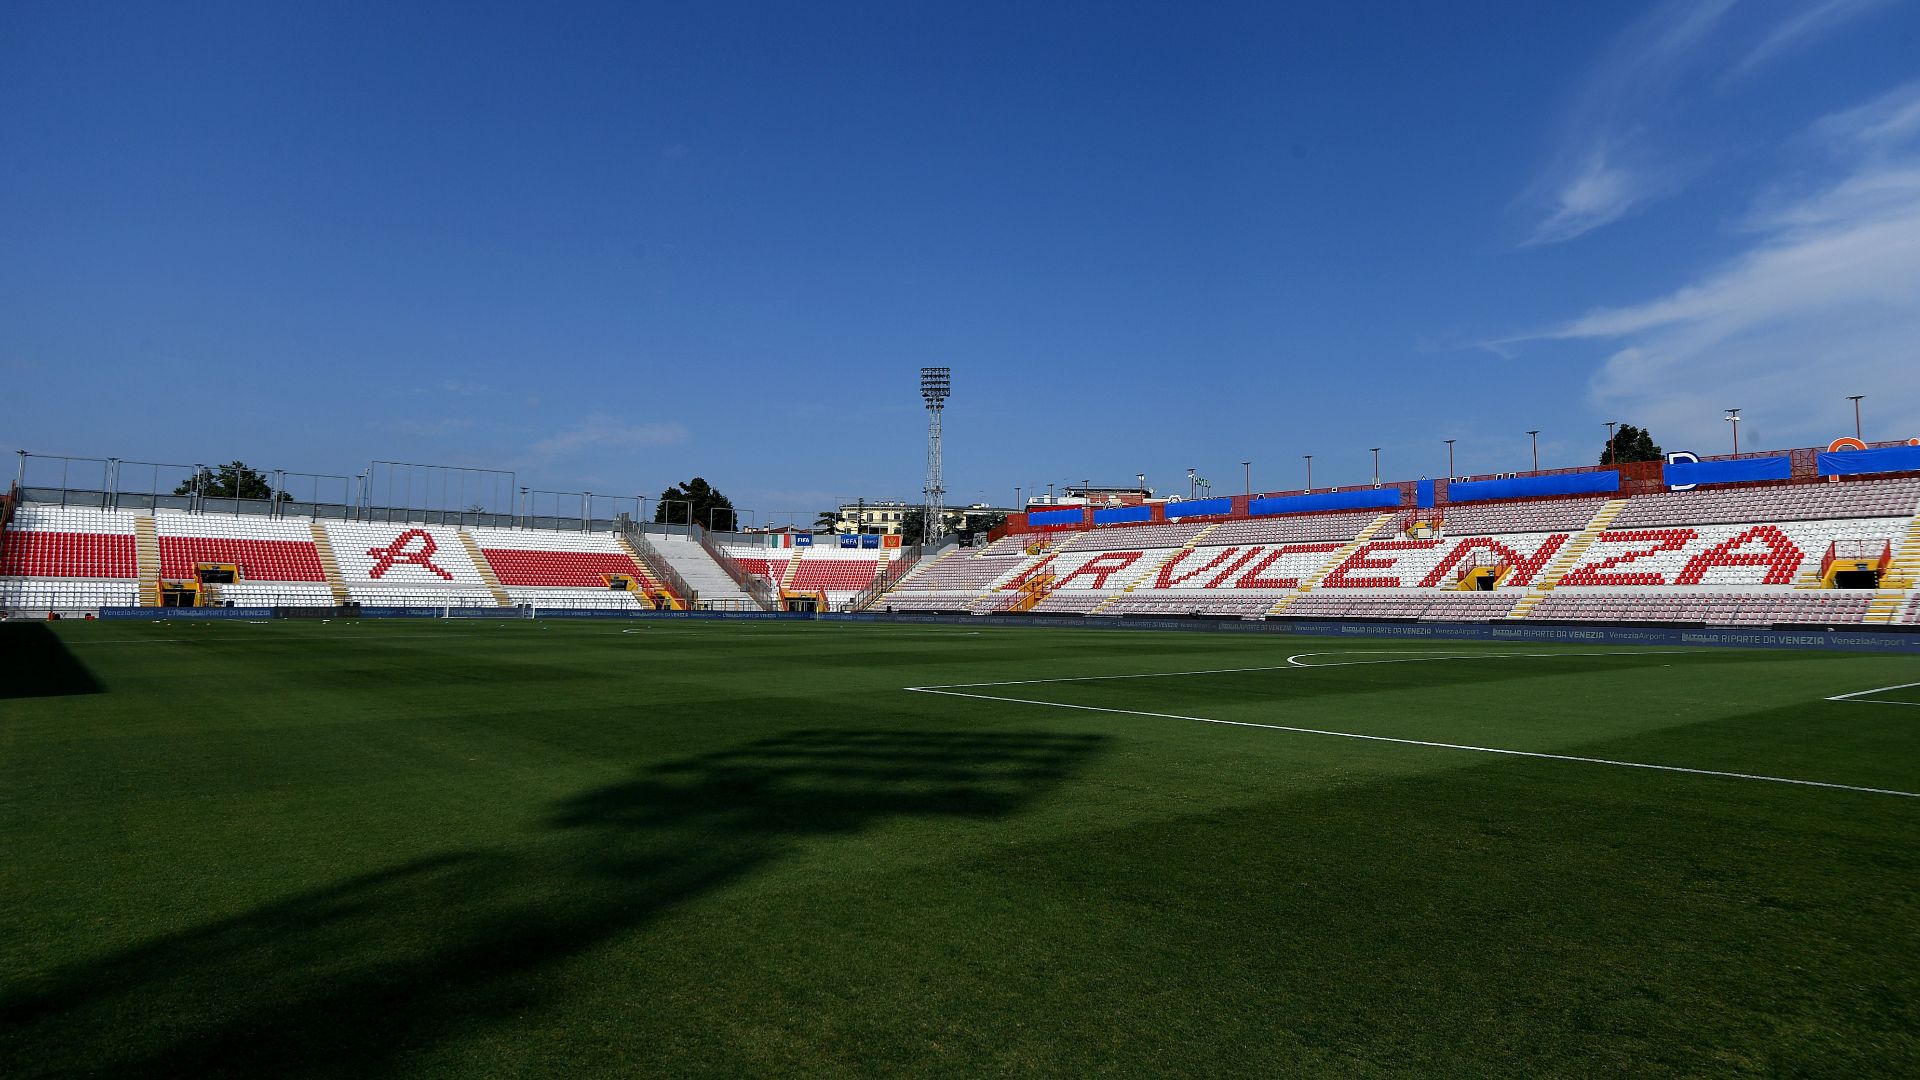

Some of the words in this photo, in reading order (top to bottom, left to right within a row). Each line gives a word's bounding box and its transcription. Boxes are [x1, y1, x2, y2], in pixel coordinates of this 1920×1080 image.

[1403, 627, 1431, 635] VENEZIA
[1523, 629, 1554, 638] RIPARTE
[1556, 630, 1567, 638] DA
[1568, 631, 1604, 639] VENEZIA
[1609, 631, 1665, 641] VeneziaAirport
[1721, 634, 1760, 644] RIPARTE
[1763, 635, 1775, 644] DA
[1778, 636, 1824, 645] VENEZIA
[1831, 637, 1905, 647] VeneziaAirport
